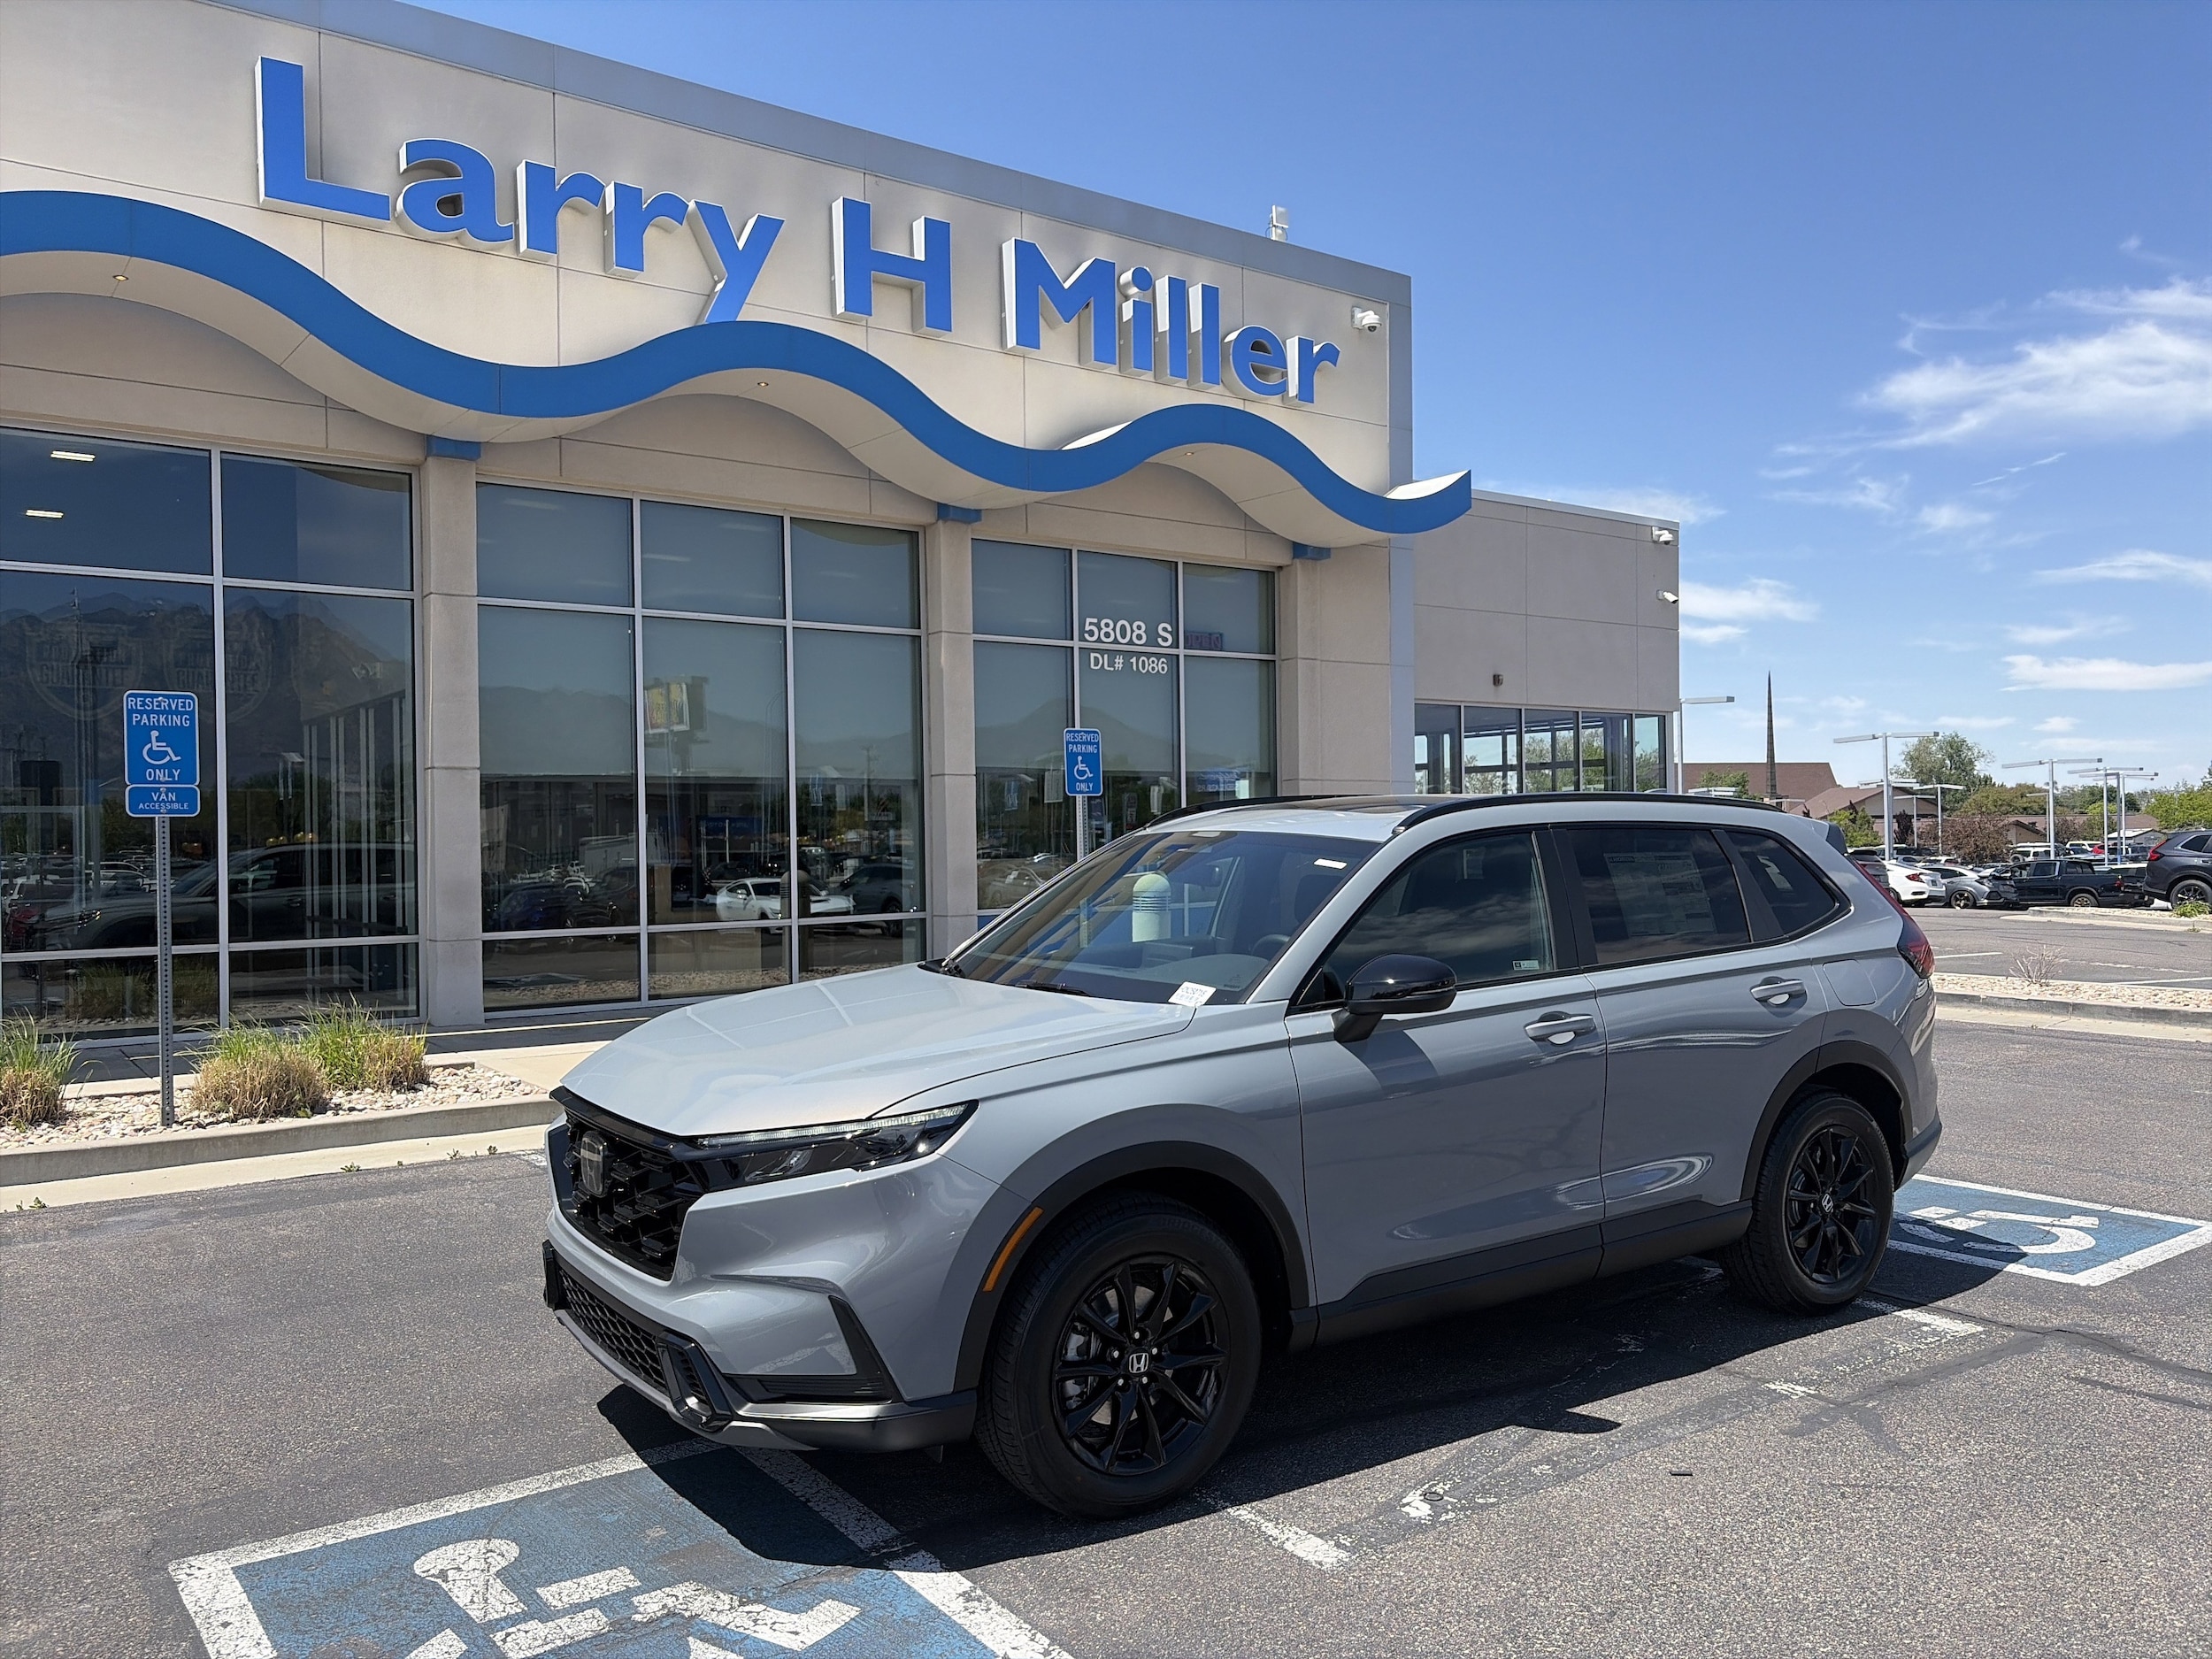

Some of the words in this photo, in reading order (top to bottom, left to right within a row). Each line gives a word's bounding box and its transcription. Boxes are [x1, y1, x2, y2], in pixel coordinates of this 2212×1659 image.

[255, 56, 784, 323] Larry
[832, 196, 952, 337] H
[1002, 237, 1340, 408] Miller
[1083, 617, 1148, 645] 5808
[1156, 622, 1173, 647] S
[1089, 652, 1124, 672] DL#
[1130, 656, 1168, 674] 1086
[127, 697, 194, 710] RESERVED
[132, 713, 190, 727] PARKING
[1065, 733, 1099, 742] RESERVED
[1068, 744, 1097, 753] PARKING
[145, 768, 181, 781] ONLY
[1075, 782, 1094, 791] ONLY
[151, 791, 176, 802] VAN
